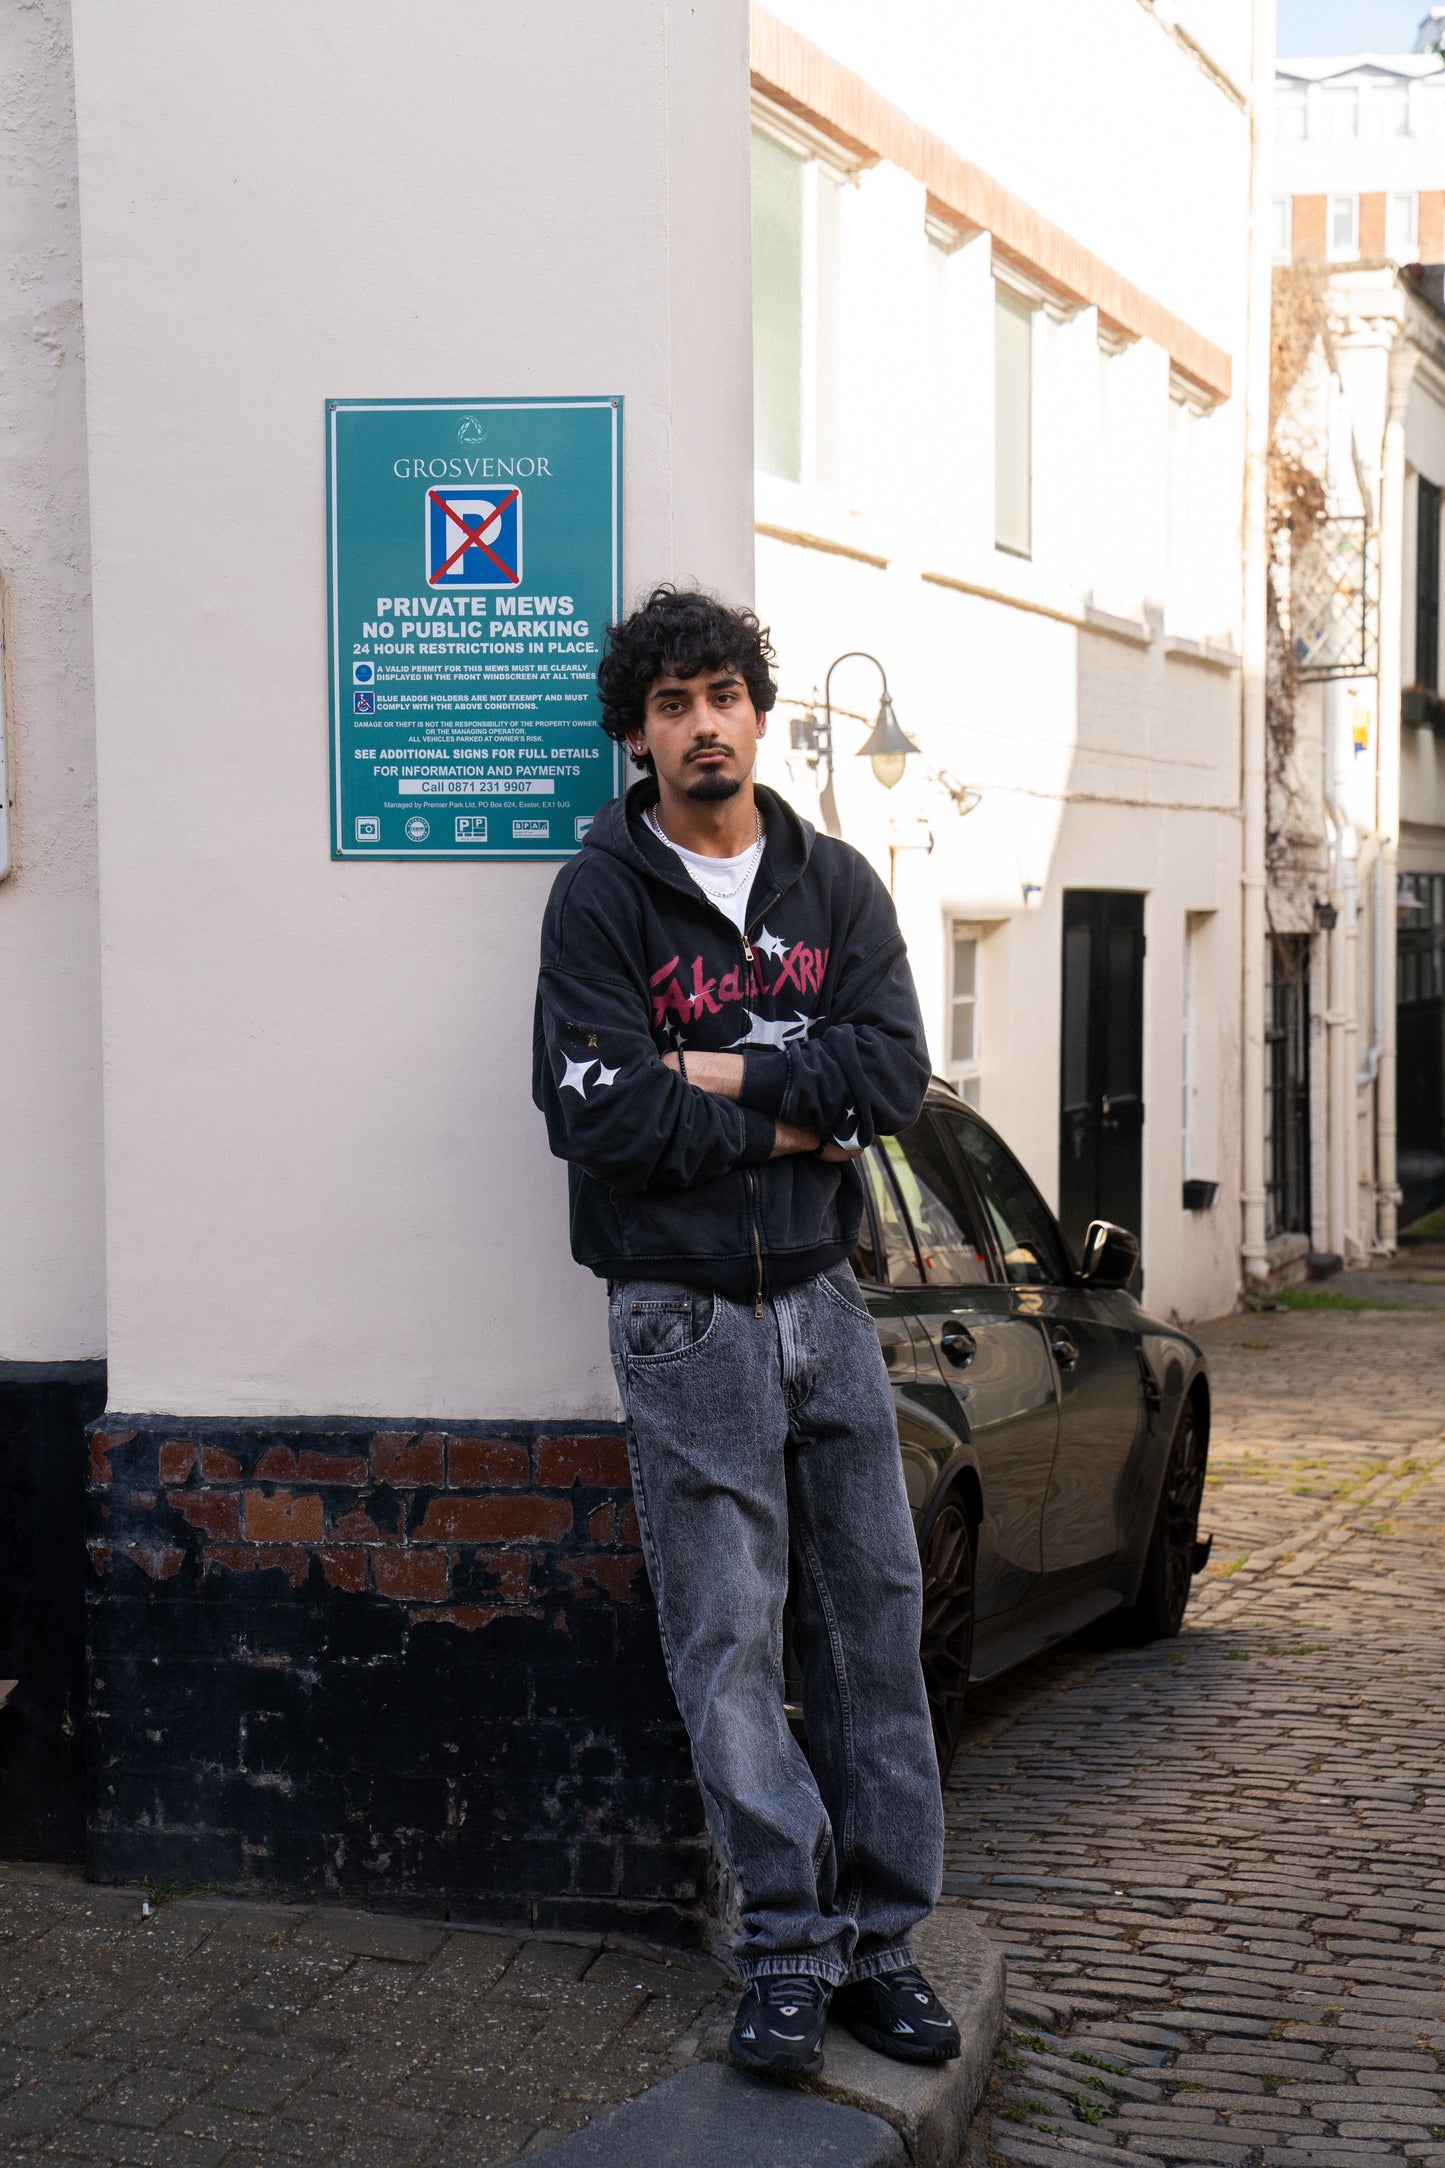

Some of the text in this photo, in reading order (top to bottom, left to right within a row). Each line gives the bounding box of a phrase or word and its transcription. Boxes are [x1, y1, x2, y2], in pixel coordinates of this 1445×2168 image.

[394, 457, 552, 478] GROSVENOR
[377, 596, 574, 617] PRIVATE MEWS
[363, 620, 589, 638] NO PUBLIC PARKING
[353, 642, 598, 654] 24 HOUR RESTRICTIONS IN PLACE.
[354, 748, 599, 759] SEE ADDITIONAL SIGNS FOR FULL DETAILS
[374, 766, 580, 776] FOR INFORMATION AND PAYMENTS
[422, 782, 532, 792] Call 0871 231 9907
[384, 801, 413, 809] Managed
